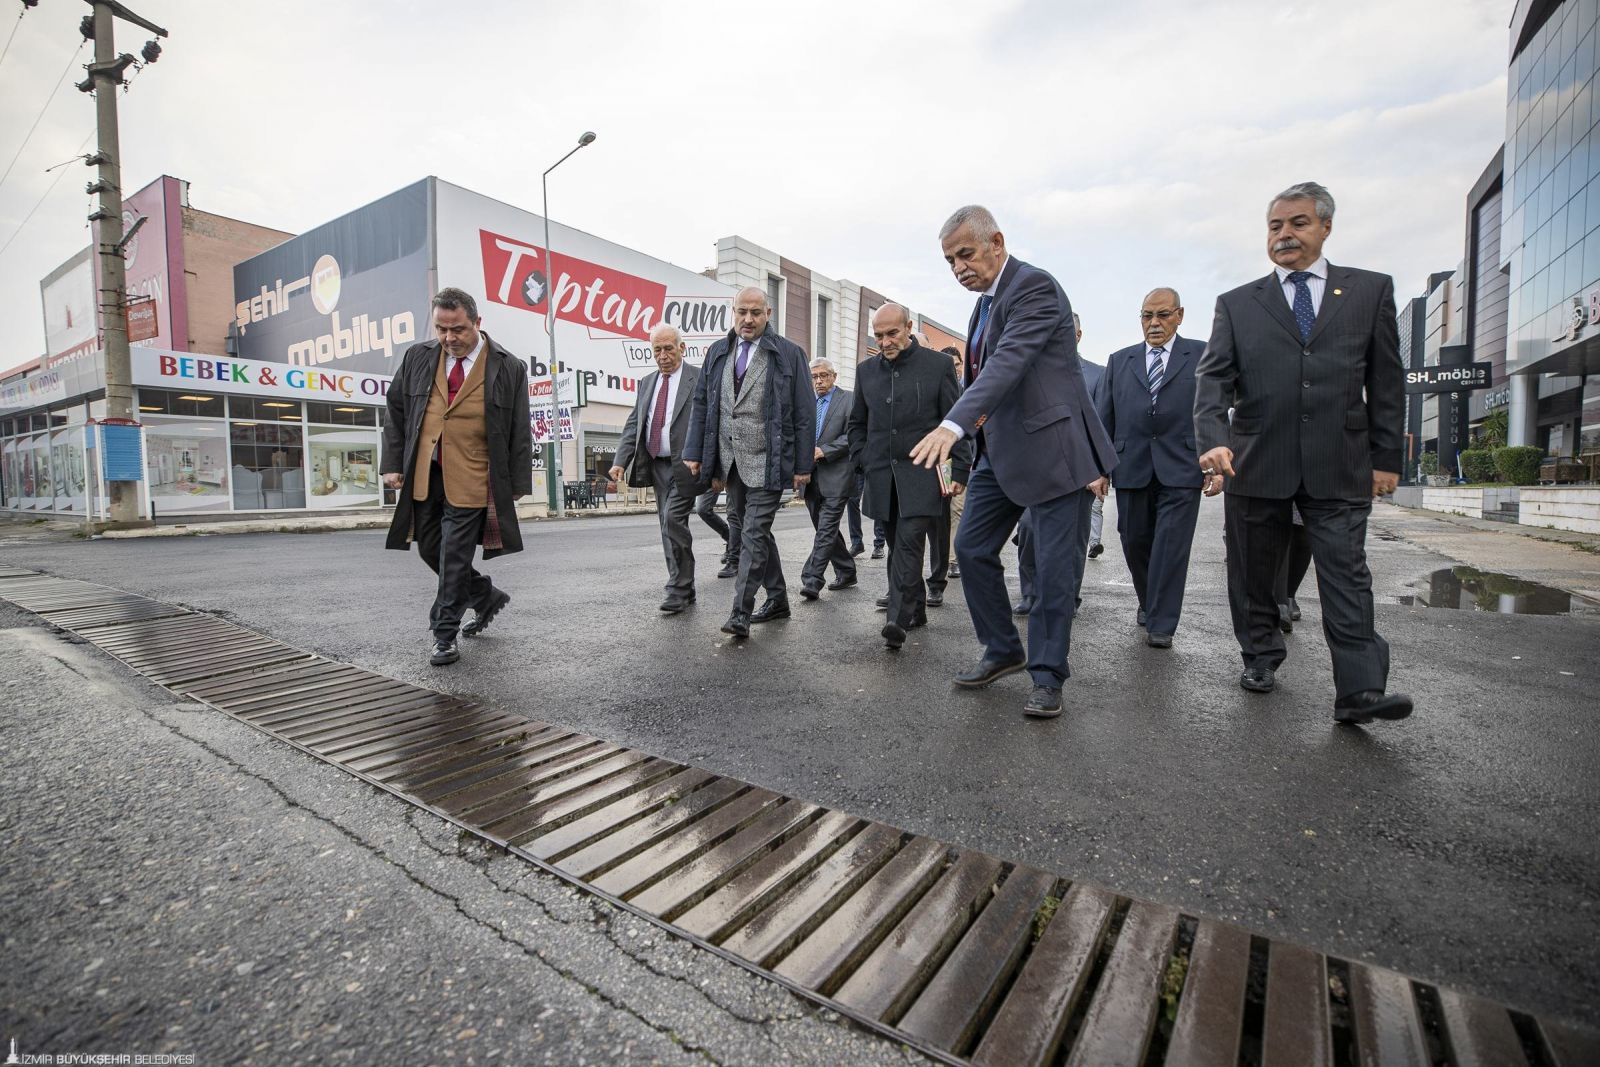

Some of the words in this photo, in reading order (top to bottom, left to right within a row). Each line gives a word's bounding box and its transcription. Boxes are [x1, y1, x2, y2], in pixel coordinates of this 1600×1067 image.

[236, 276, 310, 337] şehir
[288, 311, 415, 367] mobilya
[160, 355, 250, 384] BEBEK
[258, 367, 277, 387] &
[286, 370, 354, 398] GENÇ
